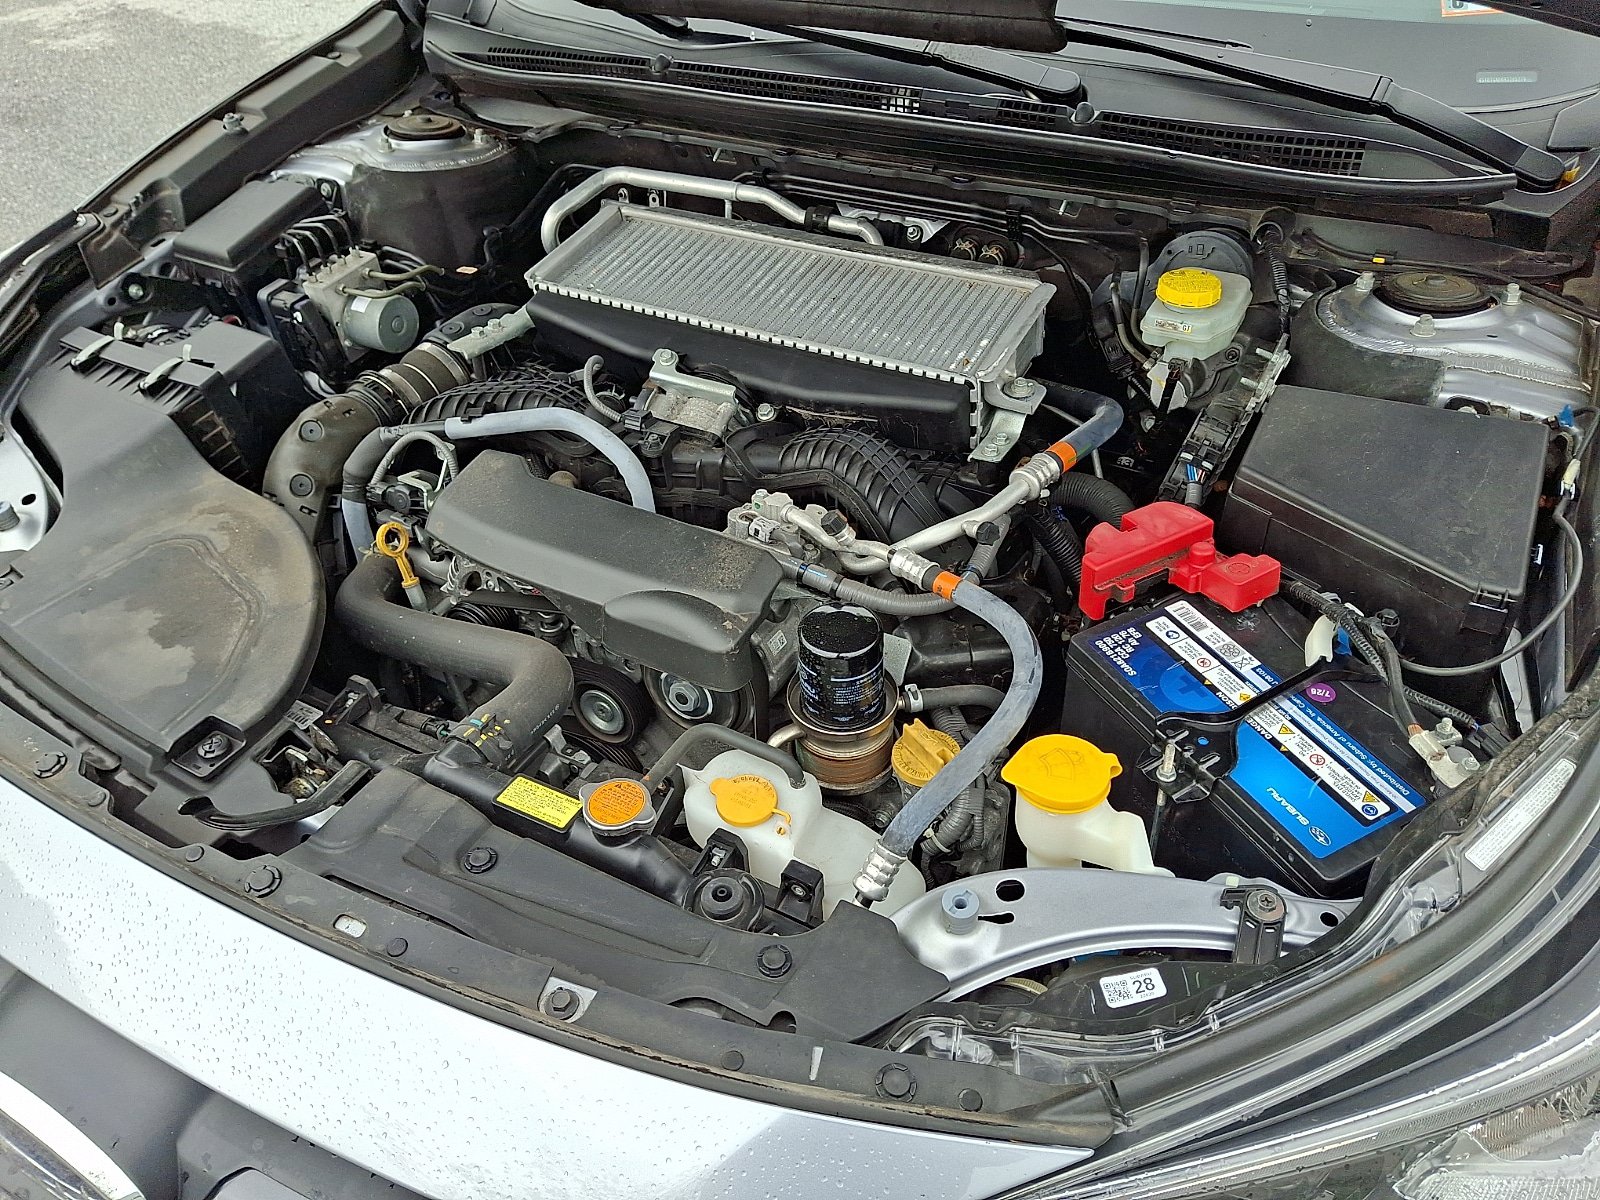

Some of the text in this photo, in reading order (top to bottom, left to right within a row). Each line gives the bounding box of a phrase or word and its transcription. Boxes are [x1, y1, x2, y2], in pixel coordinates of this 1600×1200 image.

[1127, 627, 1143, 639] EFB
[1103, 636, 1130, 660] CCA 750
[1111, 633, 1135, 653] RC 120
[1216, 691, 1238, 710] OISON
[1346, 741, 1368, 760] Subaru
[1376, 767, 1410, 796] Distributed
[1266, 787, 1310, 826] SUBARU
[1132, 977, 1155, 994] 28
